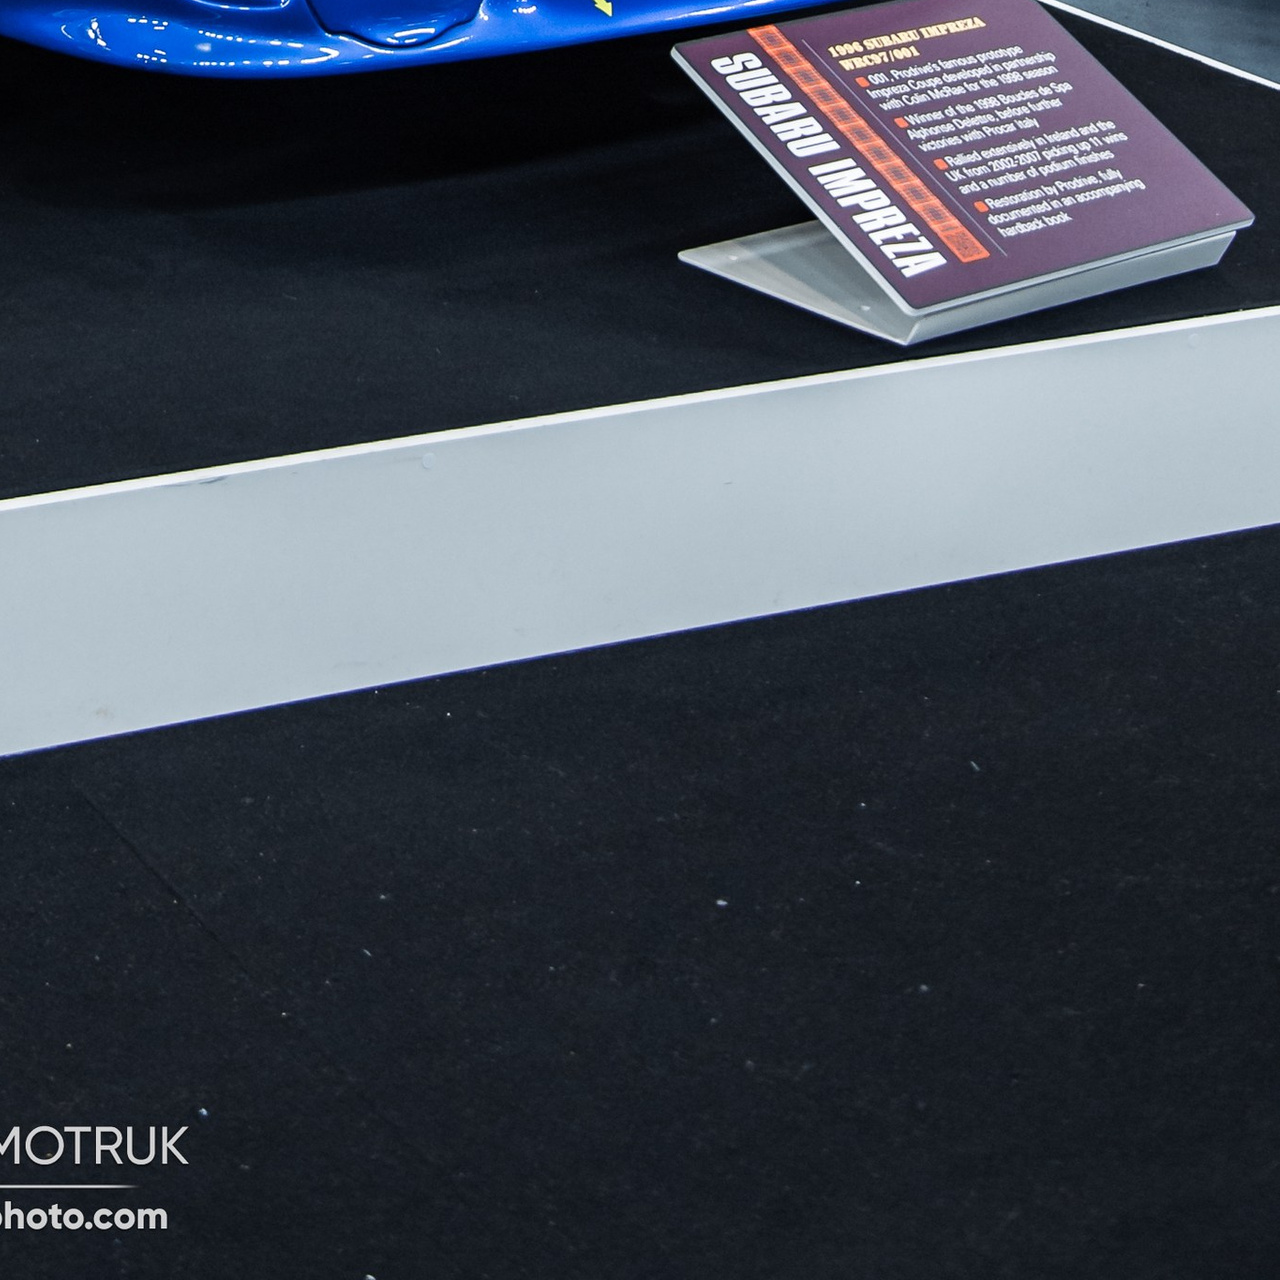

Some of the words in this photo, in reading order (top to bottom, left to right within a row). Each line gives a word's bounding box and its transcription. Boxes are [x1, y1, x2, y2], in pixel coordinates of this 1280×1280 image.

[827, 41, 864, 58] 1996
[862, 29, 921, 51] SUBARU
[918, 16, 987, 39] IMPREZA
[838, 45, 921, 71] WRC97/001
[865, 83, 911, 99] Impreza
[907, 76, 944, 91] Coupe
[941, 63, 994, 84] developed
[988, 62, 1004, 73] in
[1001, 51, 1057, 72] partnership
[889, 61, 942, 80] Prodrive's
[937, 55, 978, 70] famous
[975, 45, 1024, 64] prototype
[878, 97, 905, 111] with
[901, 92, 932, 106] Colin
[926, 85, 967, 100] McRae
[962, 81, 981, 92] for
[978, 78, 1000, 89] the
[996, 70, 1025, 85] 1998
[1021, 65, 1059, 80] season
[903, 110, 945, 126] Winner
[944, 105, 958, 118] of
[955, 103, 976, 115] the
[972, 96, 1002, 110] 1998
[996, 89, 1040, 105] Boucles
[1037, 85, 1054, 97] de
[1049, 81, 1074, 94] Spa
[906, 122, 956, 141] Alphonse
[951, 113, 1000, 130] Delettre,
[994, 105, 1031, 120] before
[1026, 97, 1063, 112] further
[917, 135, 963, 152] victories
[960, 128, 987, 143] with
[981, 122, 1017, 137] Procar
[1013, 116, 1040, 130] Italy
[710, 52, 841, 158] SUBARU
[807, 157, 948, 279] IMPREZA
[943, 149, 983, 167] Rallied
[980, 138, 1037, 160] extensively
[1031, 135, 1048, 146] in
[1042, 126, 1081, 144] Ireland
[1077, 122, 1100, 136] and
[1095, 120, 1116, 132] the
[944, 168, 967, 182] UK
[962, 165, 992, 178] from
[987, 150, 1042, 172] 2002-2007
[1041, 144, 1080, 161] picking
[1075, 140, 1092, 152] up
[1088, 136, 1104, 147] 11
[1101, 132, 1129, 145] wins
[958, 180, 982, 195] and
[978, 180, 990, 190] a
[986, 170, 1028, 188] number
[1026, 165, 1040, 178] of
[1037, 159, 1078, 177] podium
[1072, 149, 1115, 166] finishes
[984, 188, 1046, 210] Restoration
[1040, 185, 1060, 196] by
[1054, 175, 1103, 192] Prodrive,
[1097, 168, 1124, 181] fully
[987, 199, 1053, 225] documented
[1047, 198, 1064, 209] in
[1060, 196, 1078, 207] an
[1074, 178, 1147, 203] accompanying
[996, 217, 1047, 238] hardback
[1041, 211, 1073, 226] book
